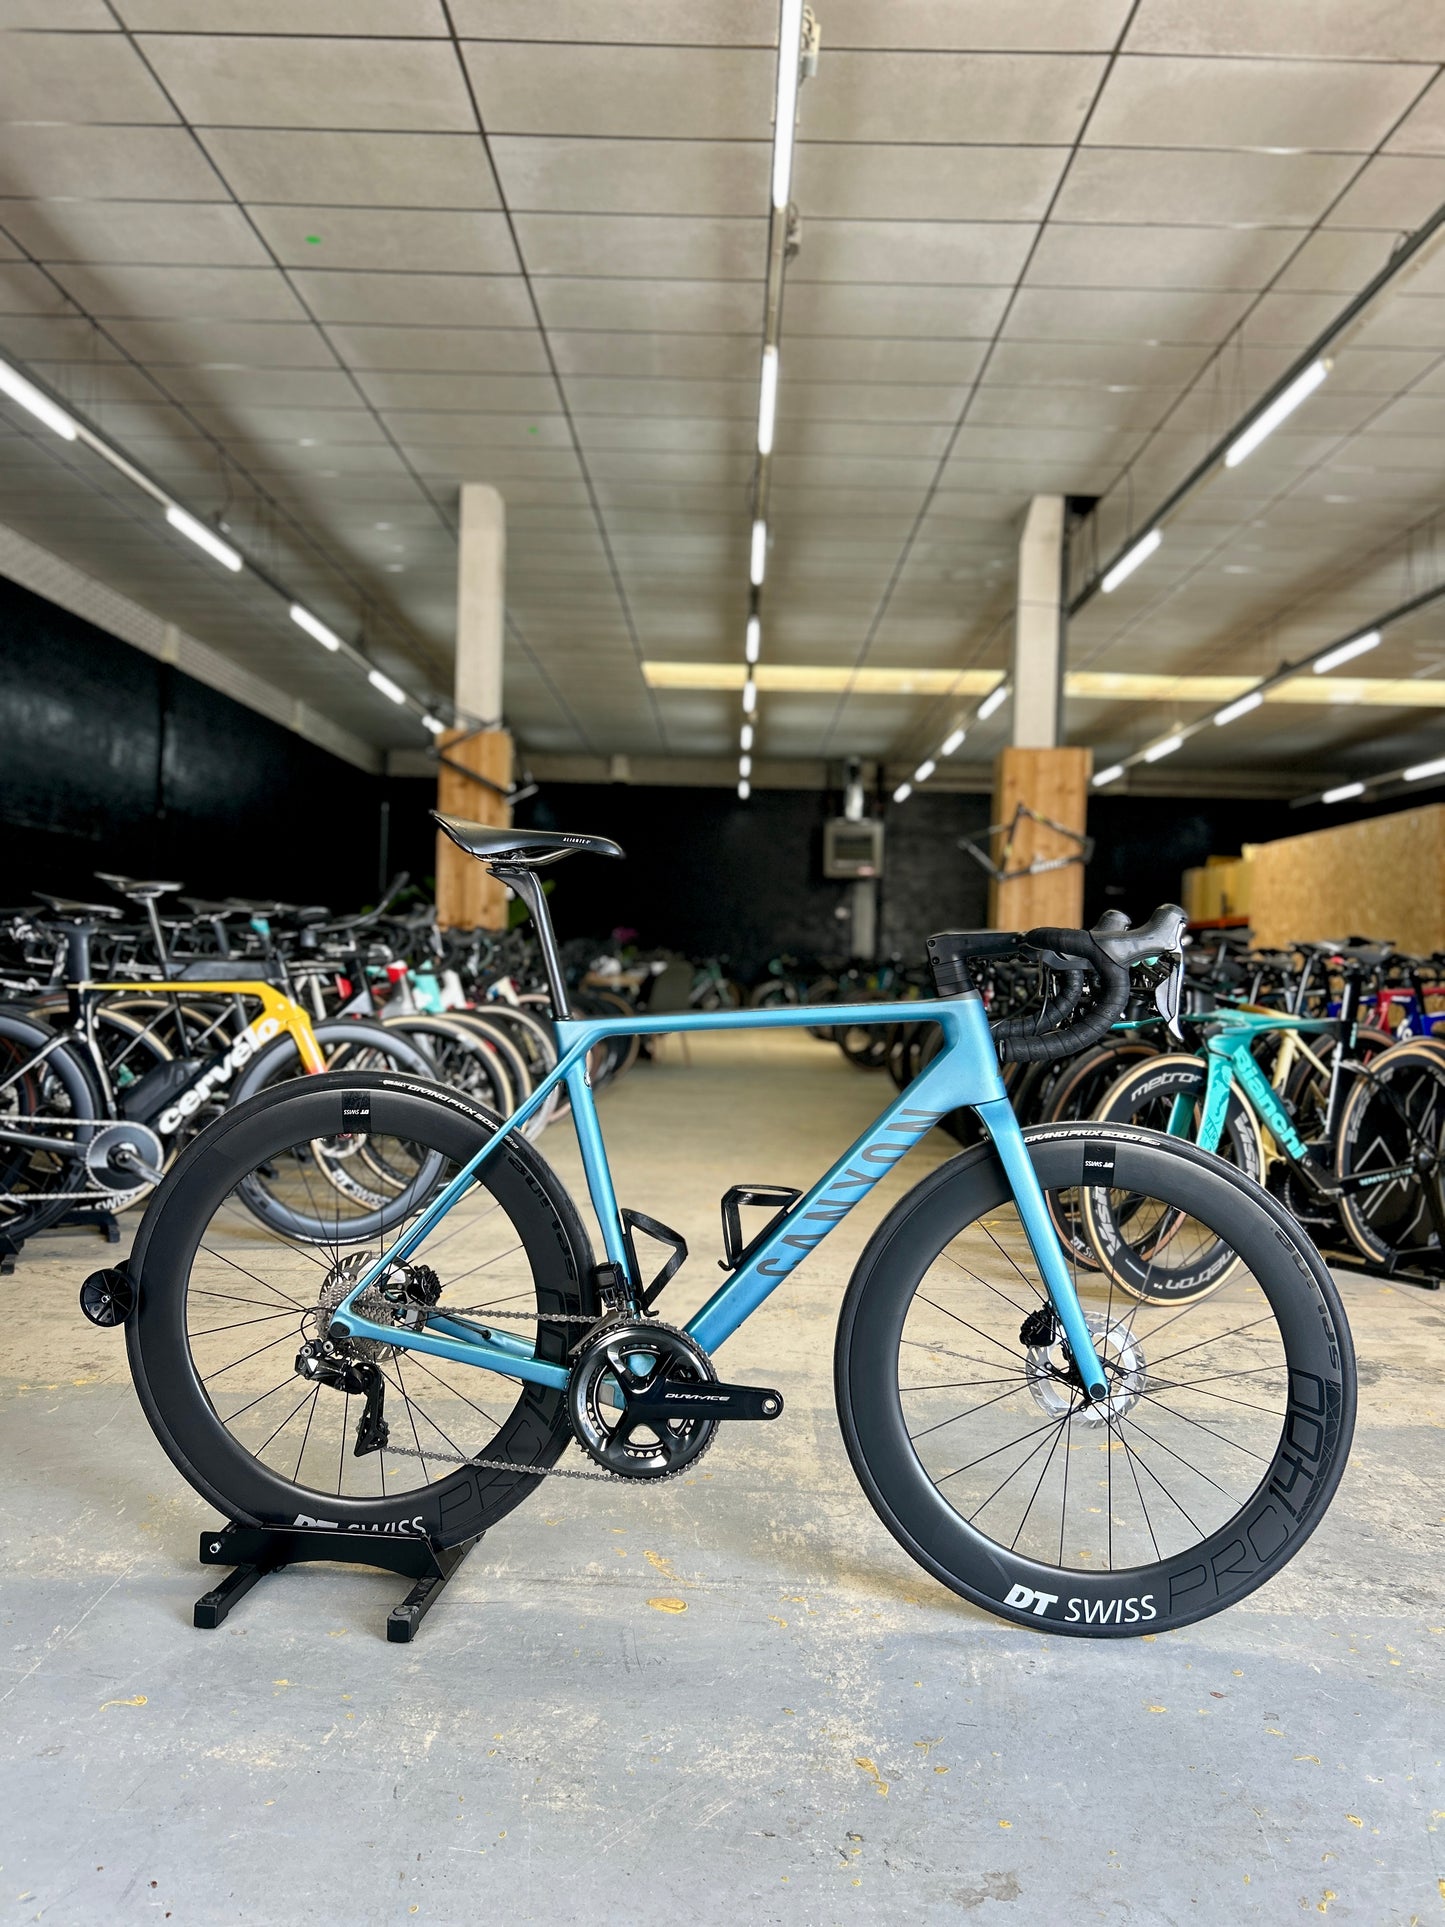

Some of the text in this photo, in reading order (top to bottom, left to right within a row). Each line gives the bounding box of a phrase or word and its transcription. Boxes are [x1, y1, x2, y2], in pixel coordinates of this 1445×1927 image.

[473, 1113, 500, 1132] 500
[1232, 1044, 1308, 1160] Bianchi
[756, 1108, 946, 1277] CANYON
[1002, 1582, 1158, 1625] DT SWISS
